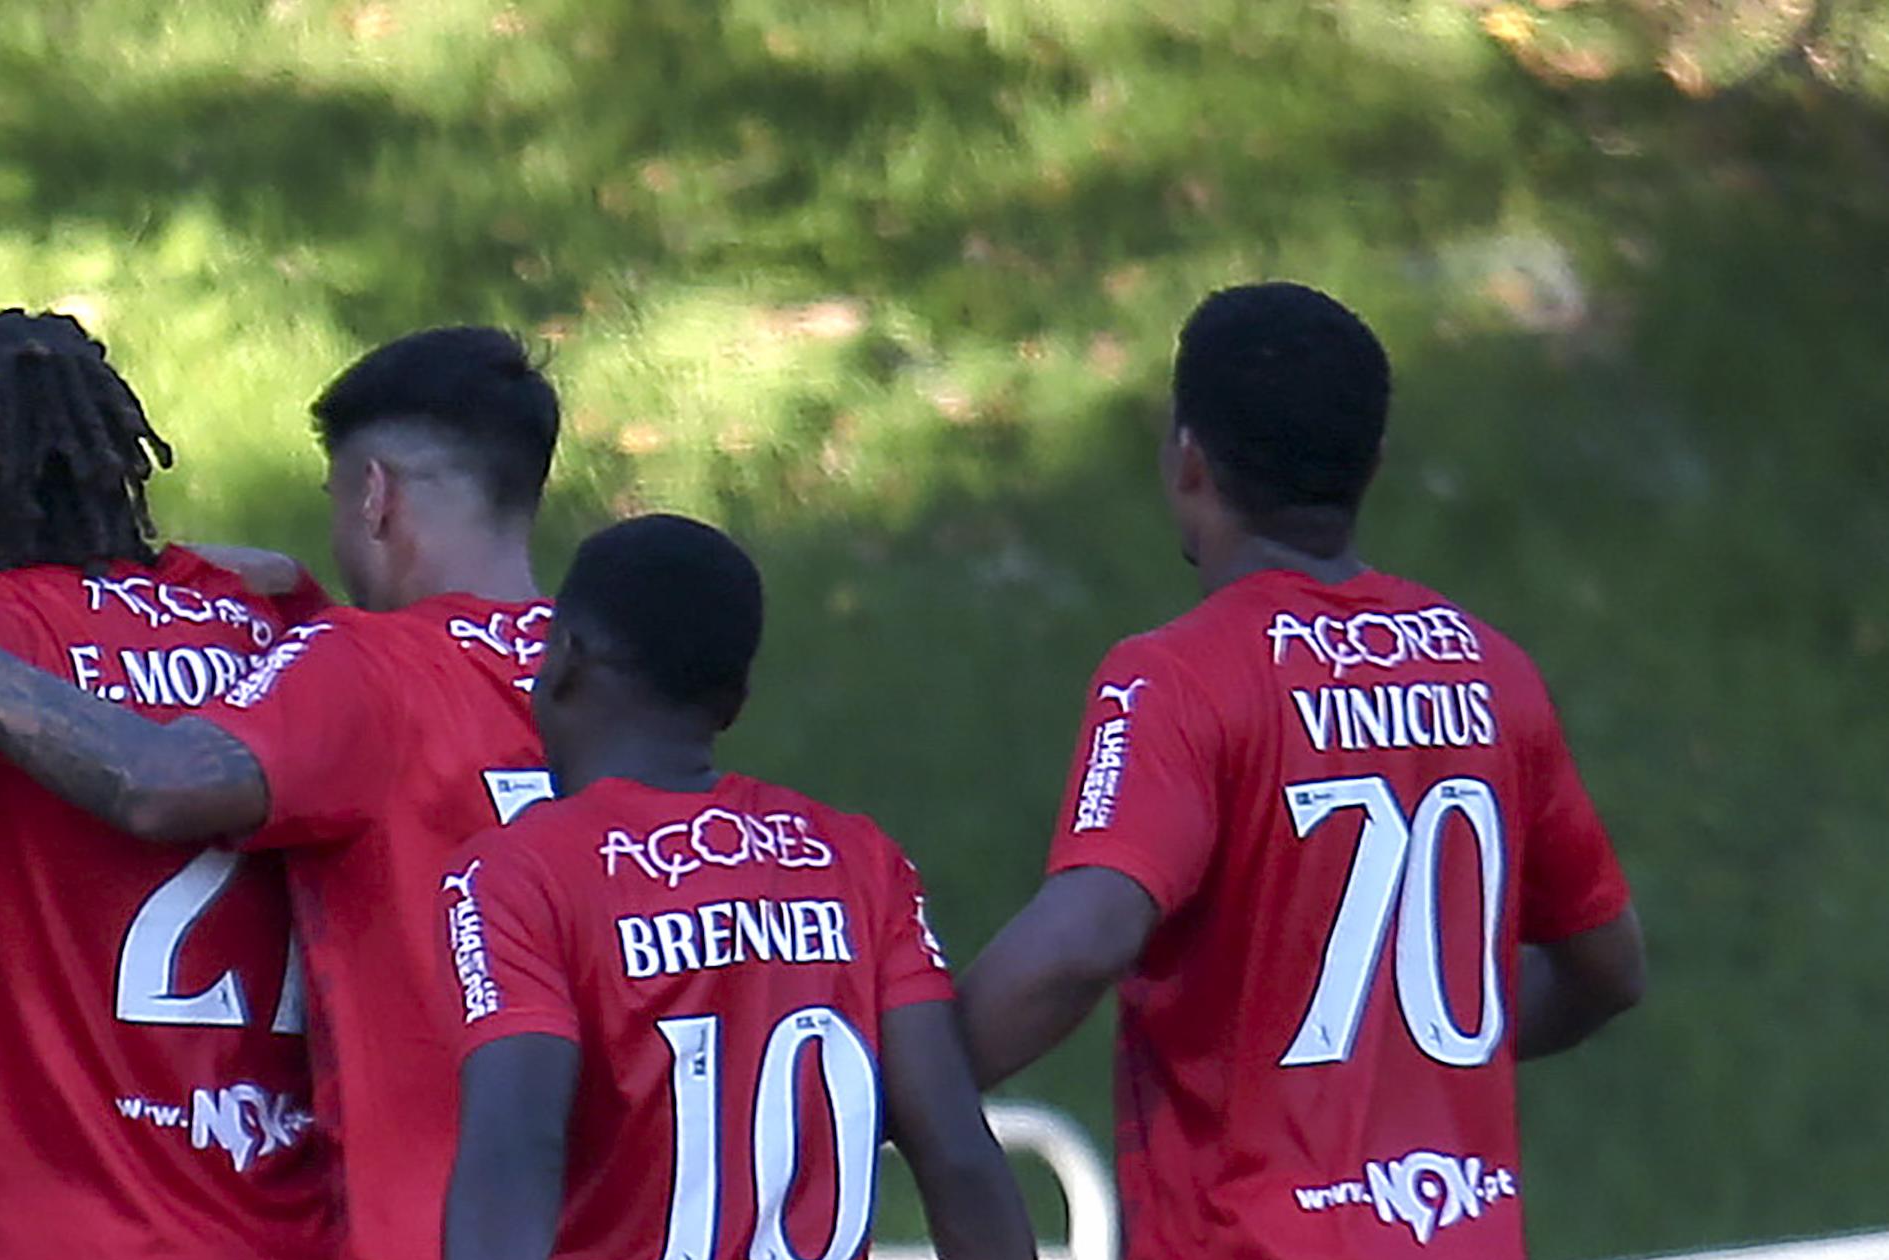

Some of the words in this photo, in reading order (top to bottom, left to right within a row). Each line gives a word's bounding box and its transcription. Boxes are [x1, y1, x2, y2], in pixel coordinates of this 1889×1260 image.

[1291, 682, 1498, 751] VINICIUS
[599, 808, 833, 888] AÇORES
[1279, 776, 1504, 1066] 70
